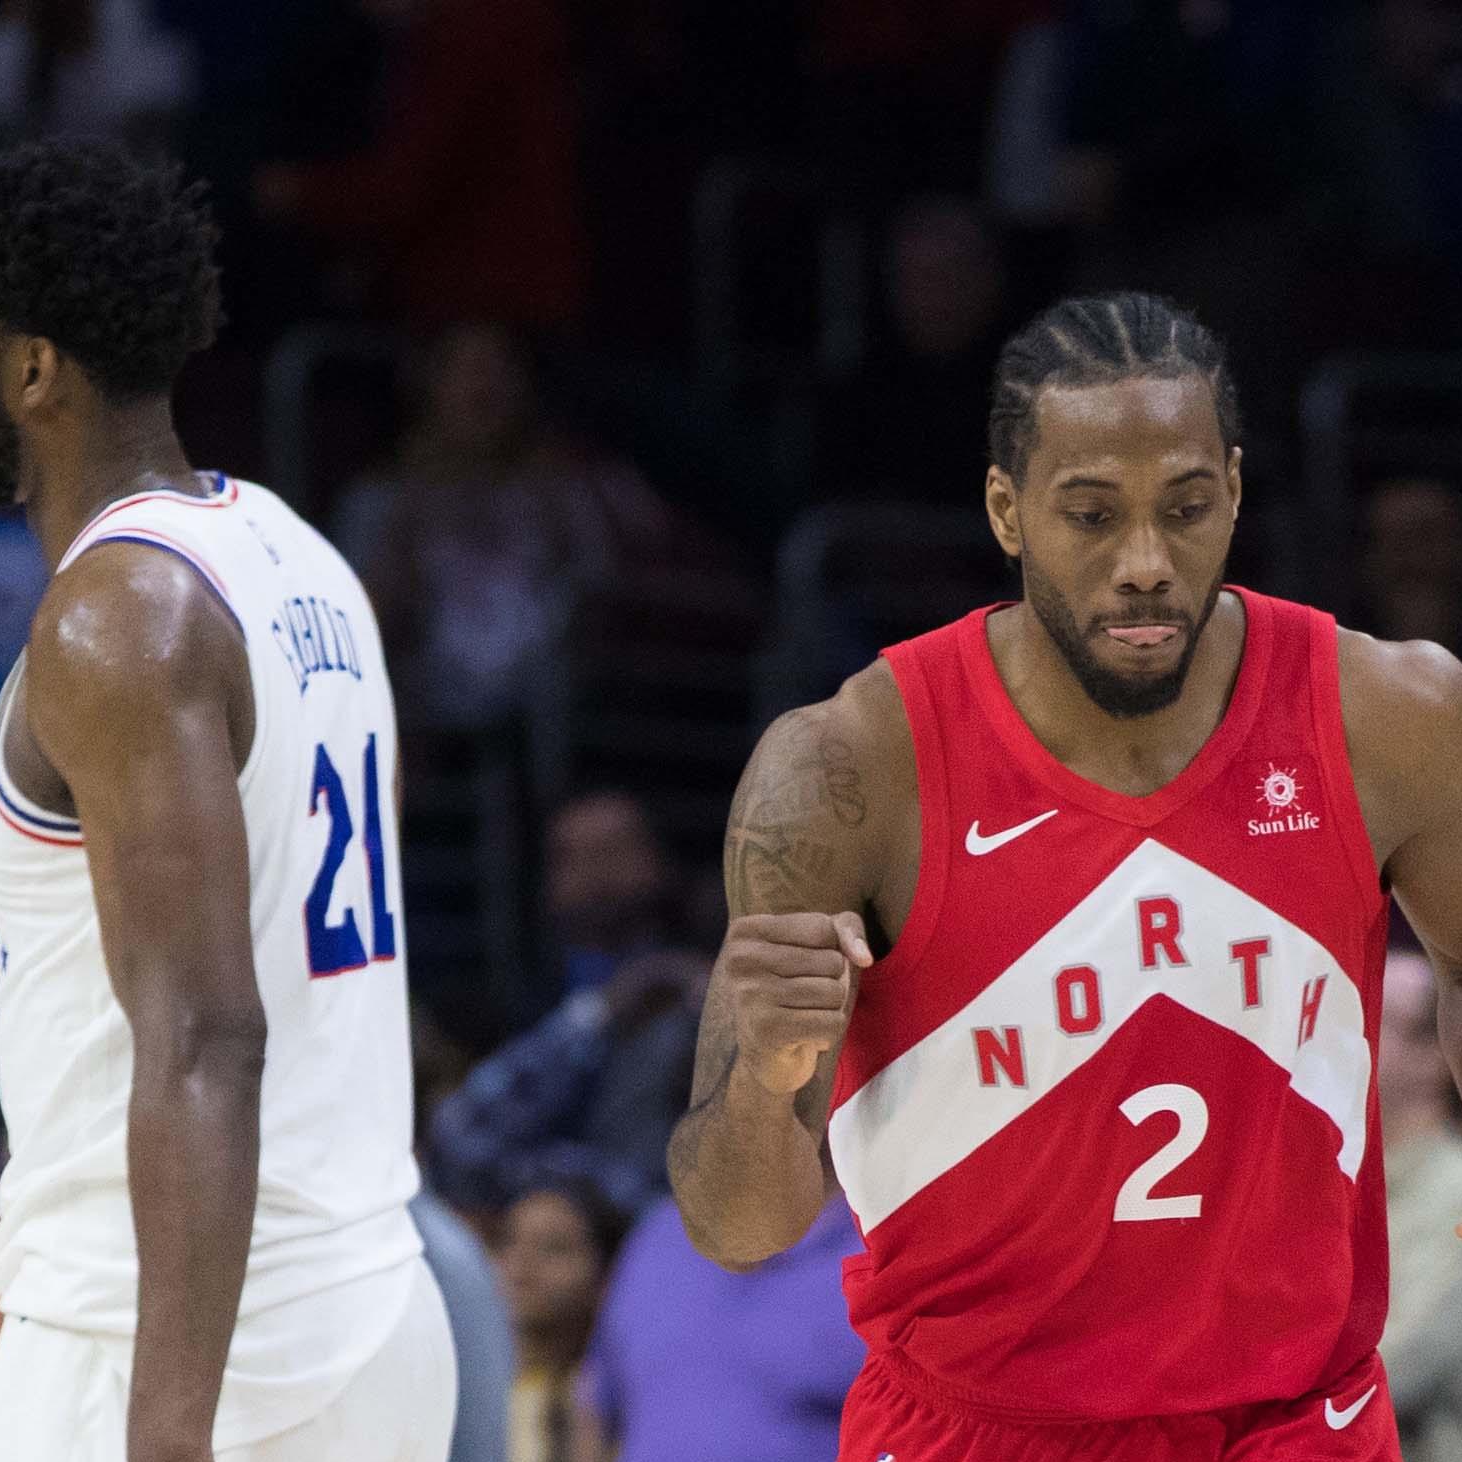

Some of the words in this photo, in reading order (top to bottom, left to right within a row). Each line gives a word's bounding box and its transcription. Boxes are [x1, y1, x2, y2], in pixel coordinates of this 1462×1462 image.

[303, 732, 396, 981] 21
[1248, 819, 1286, 836] Sun
[1287, 811, 1320, 831] Life
[972, 893, 1329, 1090] NORTH
[1113, 1083, 1209, 1222] 2
